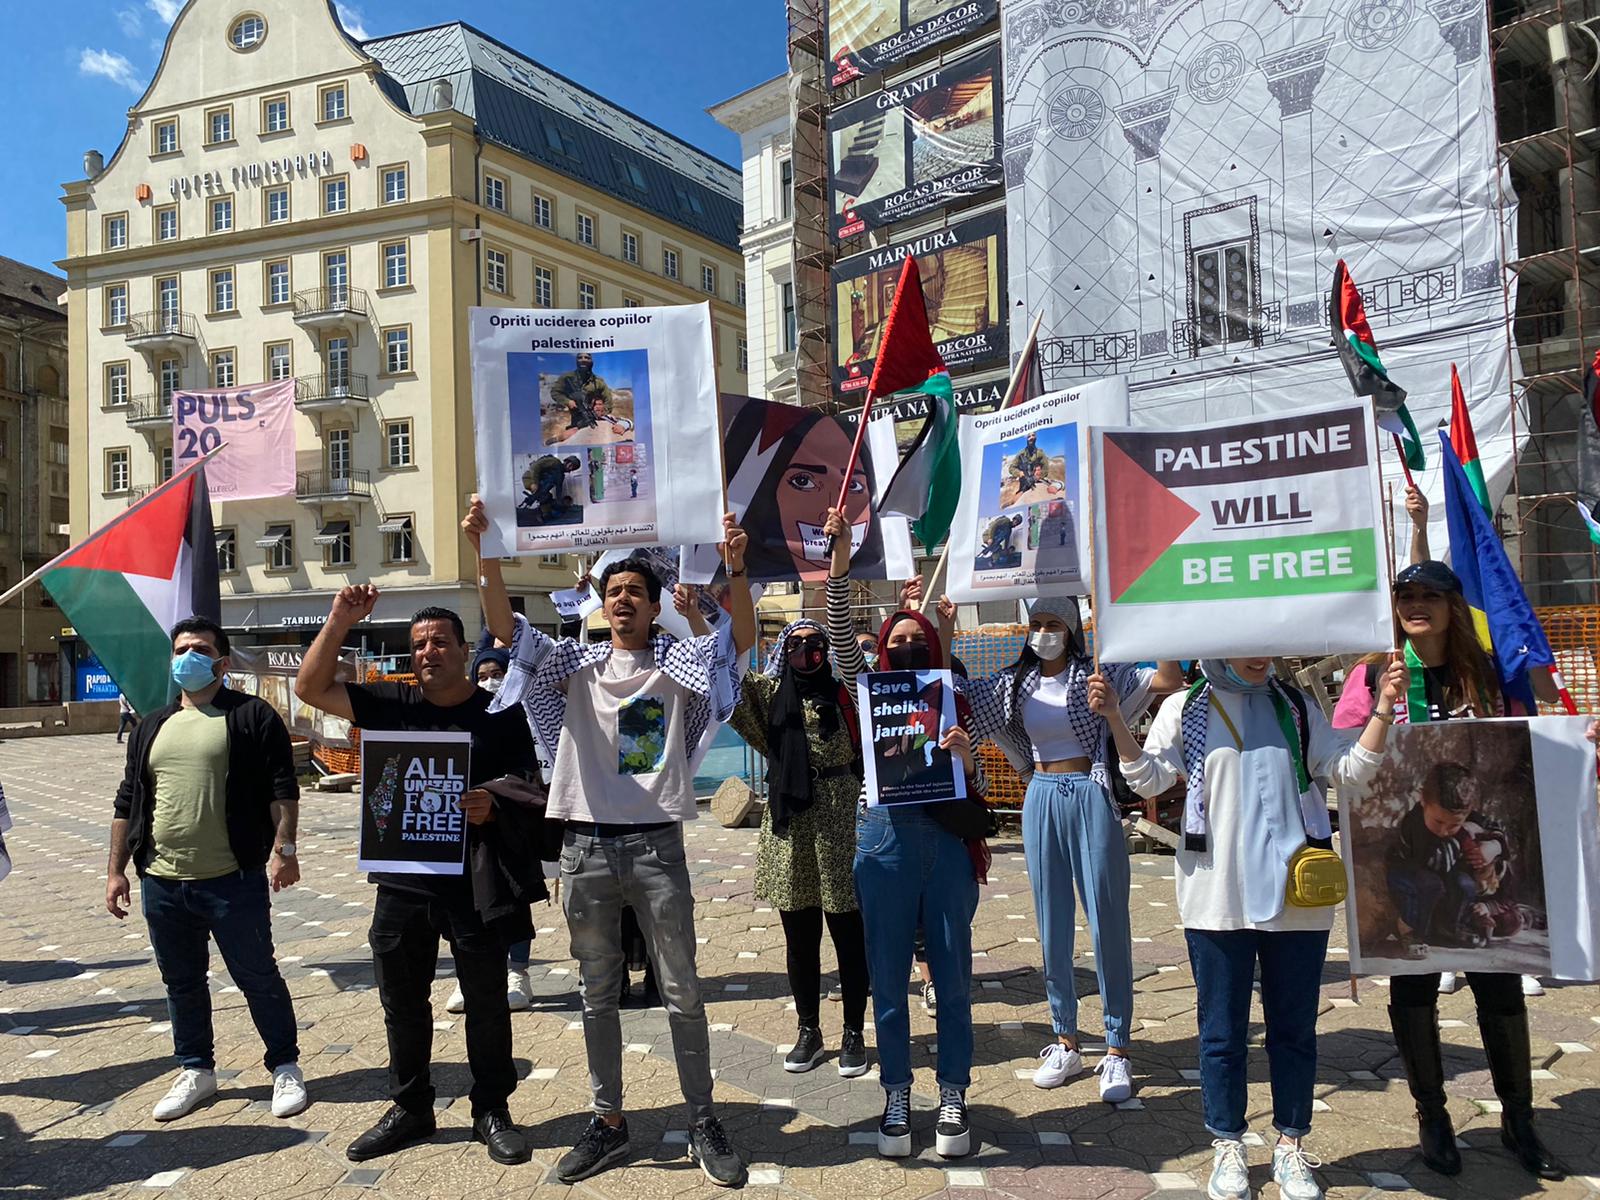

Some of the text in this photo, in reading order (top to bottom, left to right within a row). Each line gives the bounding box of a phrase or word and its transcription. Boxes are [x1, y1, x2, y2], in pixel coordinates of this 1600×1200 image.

[879, 25, 924, 53] ROCAS
[927, 3, 978, 32] DECOR
[876, 72, 942, 110] GRANIT
[169, 170, 222, 194] HOTEL
[884, 185, 930, 210] ROCAS
[933, 167, 984, 191] DECOR
[868, 229, 959, 271] MARMURA
[489, 312, 653, 330] Opriti uciderea copiilor
[531, 335, 615, 350] palestinieni
[937, 334, 987, 355] DECOR
[177, 390, 256, 426] PULS
[906, 384, 1002, 414] NARALA
[974, 391, 1081, 430] Opriti uciderea copiilor
[1000, 414, 1053, 441] palestinieni
[178, 426, 222, 459] 20
[1154, 423, 1352, 473] PALESTINE
[1211, 491, 1312, 526] WILL
[1181, 545, 1353, 585] BE FREE
[281, 615, 328, 626] STARBUCK
[267, 652, 303, 666] ROCAS
[871, 681, 911, 696] Save
[873, 699, 929, 717] sheikh
[874, 721, 925, 742] jarrah
[404, 757, 464, 779] ALL
[404, 779, 464, 793] UNITED
[403, 792, 462, 813] FOR
[402, 813, 462, 831] FREE
[402, 832, 461, 842] PALESTINE
